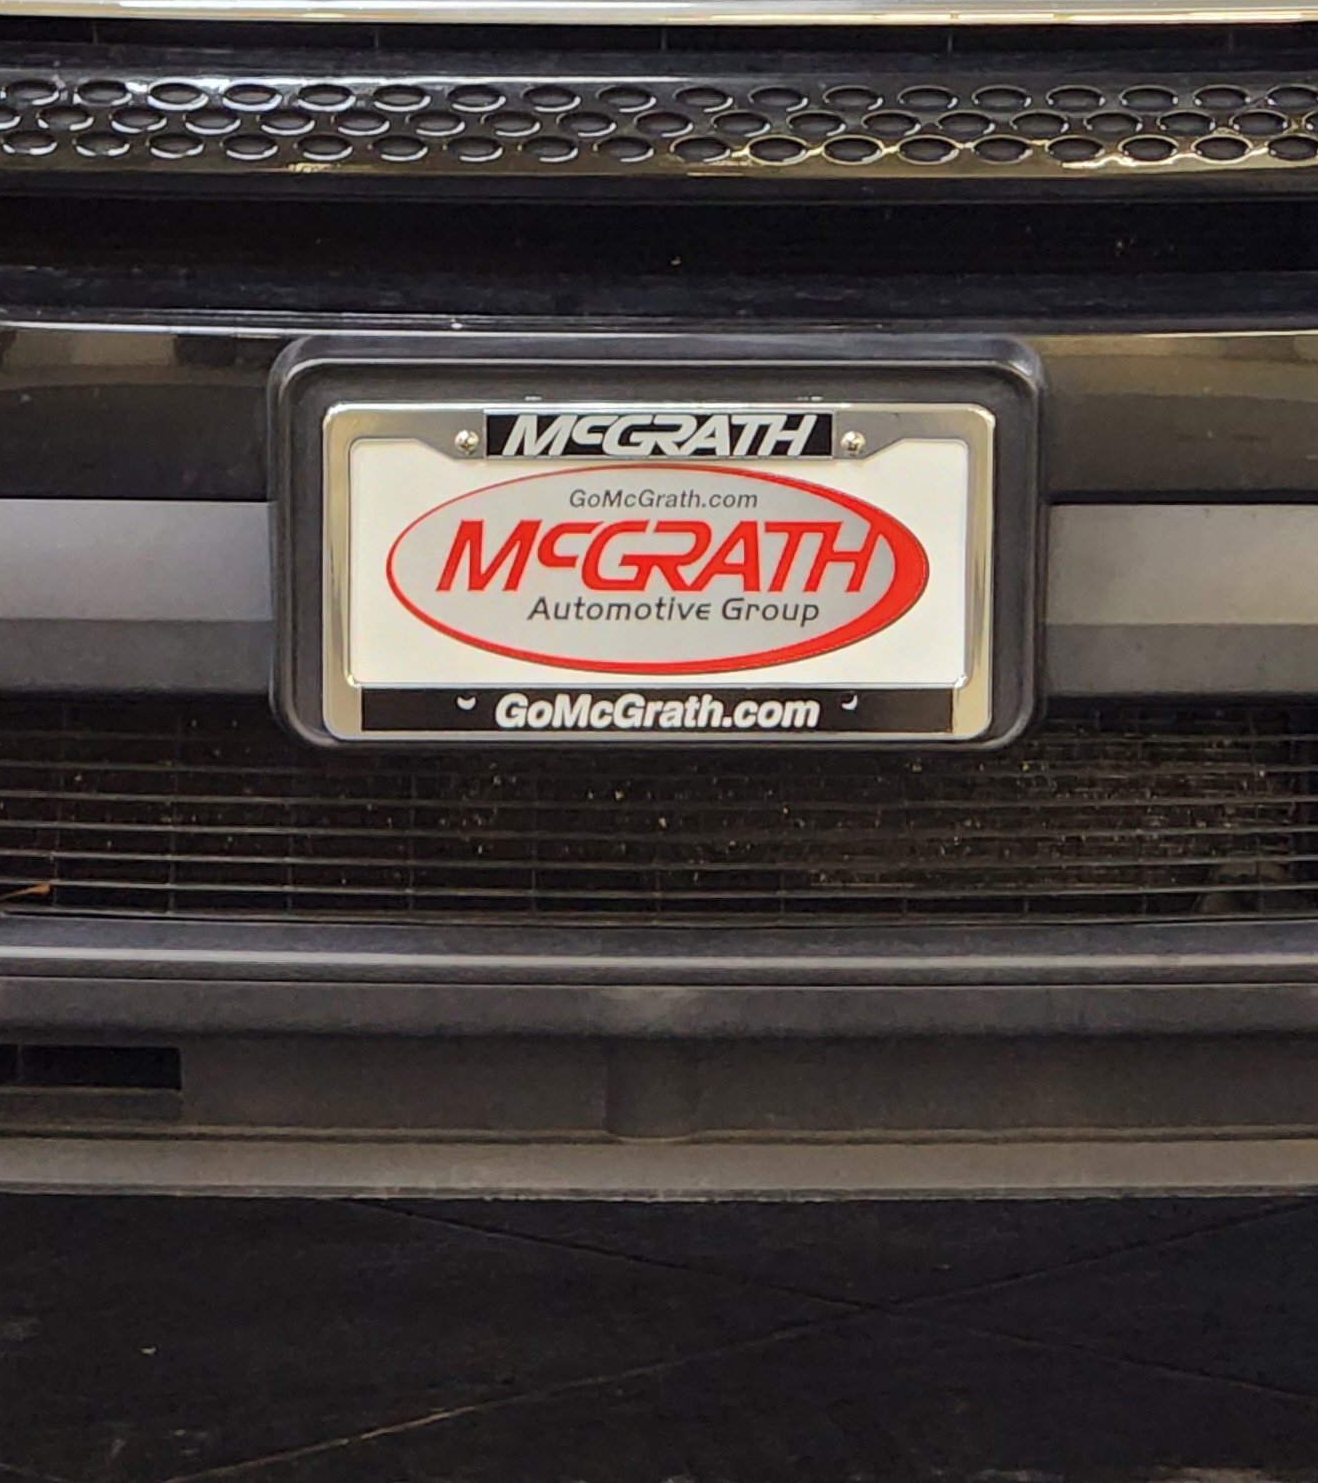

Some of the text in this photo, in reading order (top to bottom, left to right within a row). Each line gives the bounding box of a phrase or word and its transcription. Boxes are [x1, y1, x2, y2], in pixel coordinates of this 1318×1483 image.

[568, 489, 758, 510] GoMcGrath.com
[527, 597, 819, 626] Automotive Group
[496, 693, 819, 729] GoMcGrath.com
